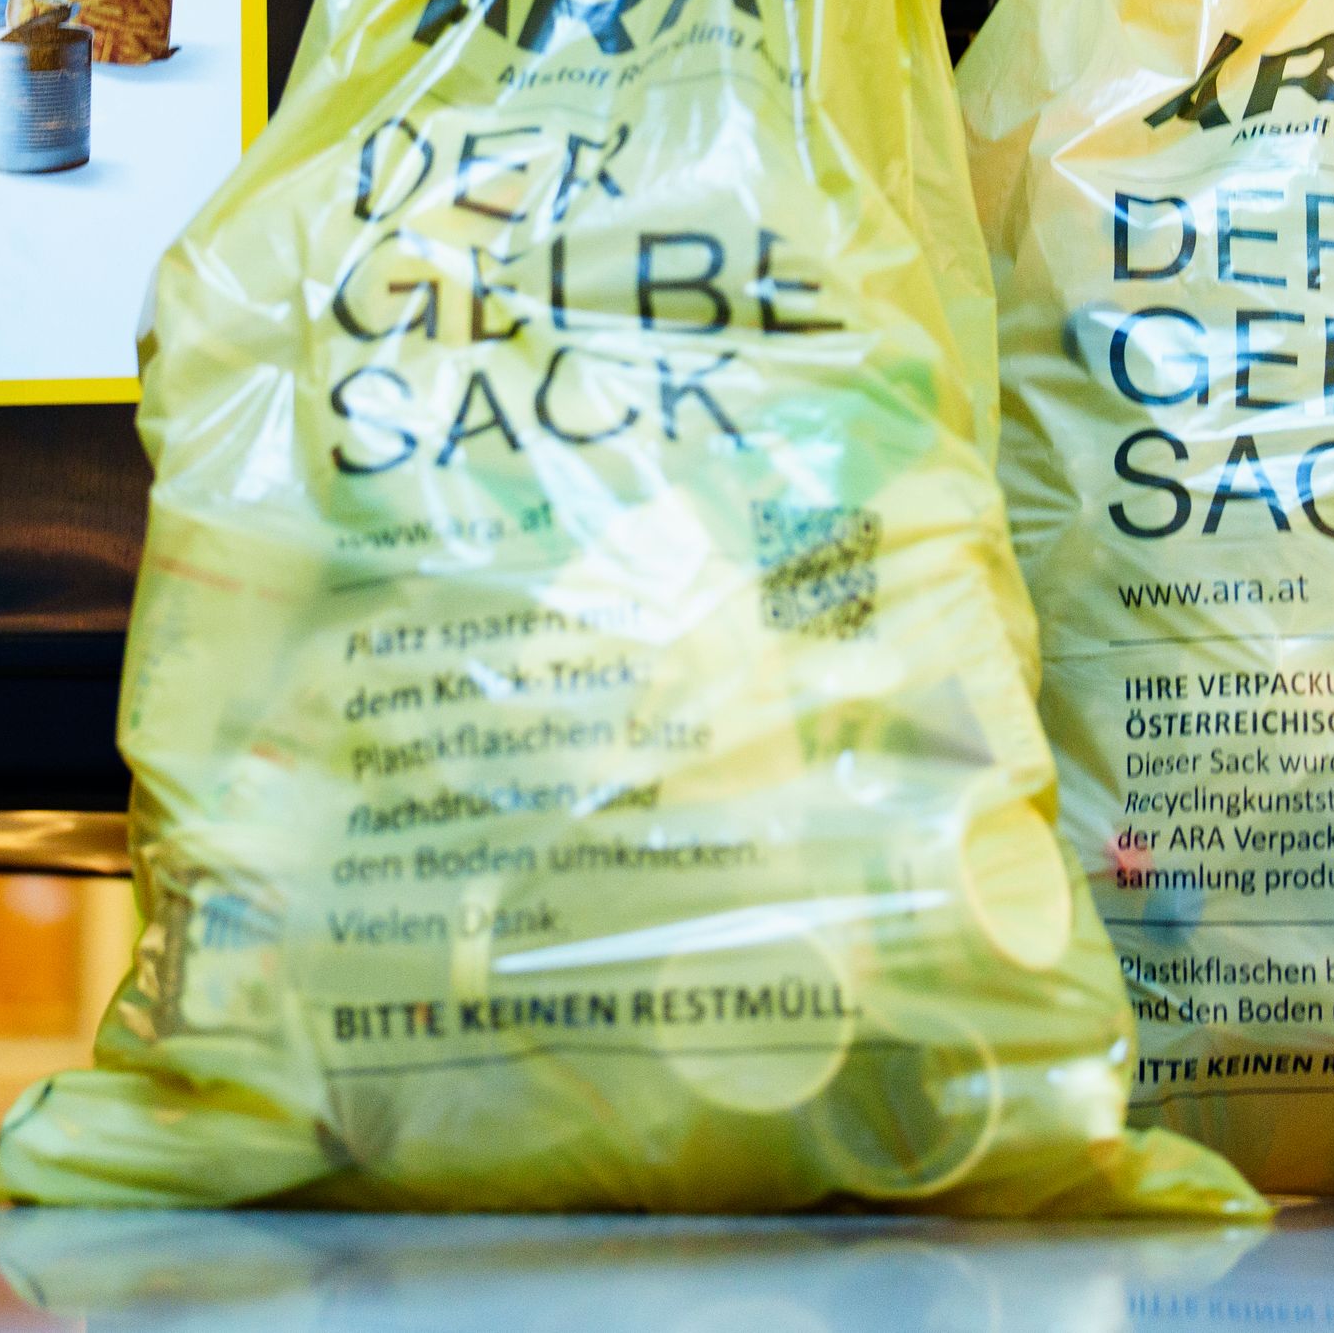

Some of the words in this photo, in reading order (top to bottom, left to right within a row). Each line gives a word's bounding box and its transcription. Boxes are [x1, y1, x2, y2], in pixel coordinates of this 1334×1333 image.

[1230, 113, 1331, 147] Altstoff
[354, 116, 631, 223] DER
[332, 228, 845, 343] GELBE
[330, 346, 750, 476] SACK
[1118, 574, 1310, 610] www.ara.at
[344, 680, 423, 722] dem
[1124, 674, 1189, 701] IHRE
[1125, 750, 1203, 778] Dieser
[1209, 748, 1269, 776] Sack
[1117, 825, 1159, 853] der
[1168, 826, 1226, 852] ARA
[332, 850, 403, 888] den
[415, 840, 536, 879] Boden
[1116, 862, 1257, 895] sammlung
[1120, 955, 1317, 986] Plastikflaschen
[332, 1001, 445, 1043] BITTE
[459, 993, 618, 1033] KEINEN
[632, 977, 865, 1026] RESTMÜLL.
[1131, 996, 1170, 1023] nd
[1178, 995, 1228, 1024] den
[1238, 995, 1324, 1024] Boden
[1132, 1056, 1199, 1085] ITTE
[1206, 1052, 1314, 1079] KEINEN
